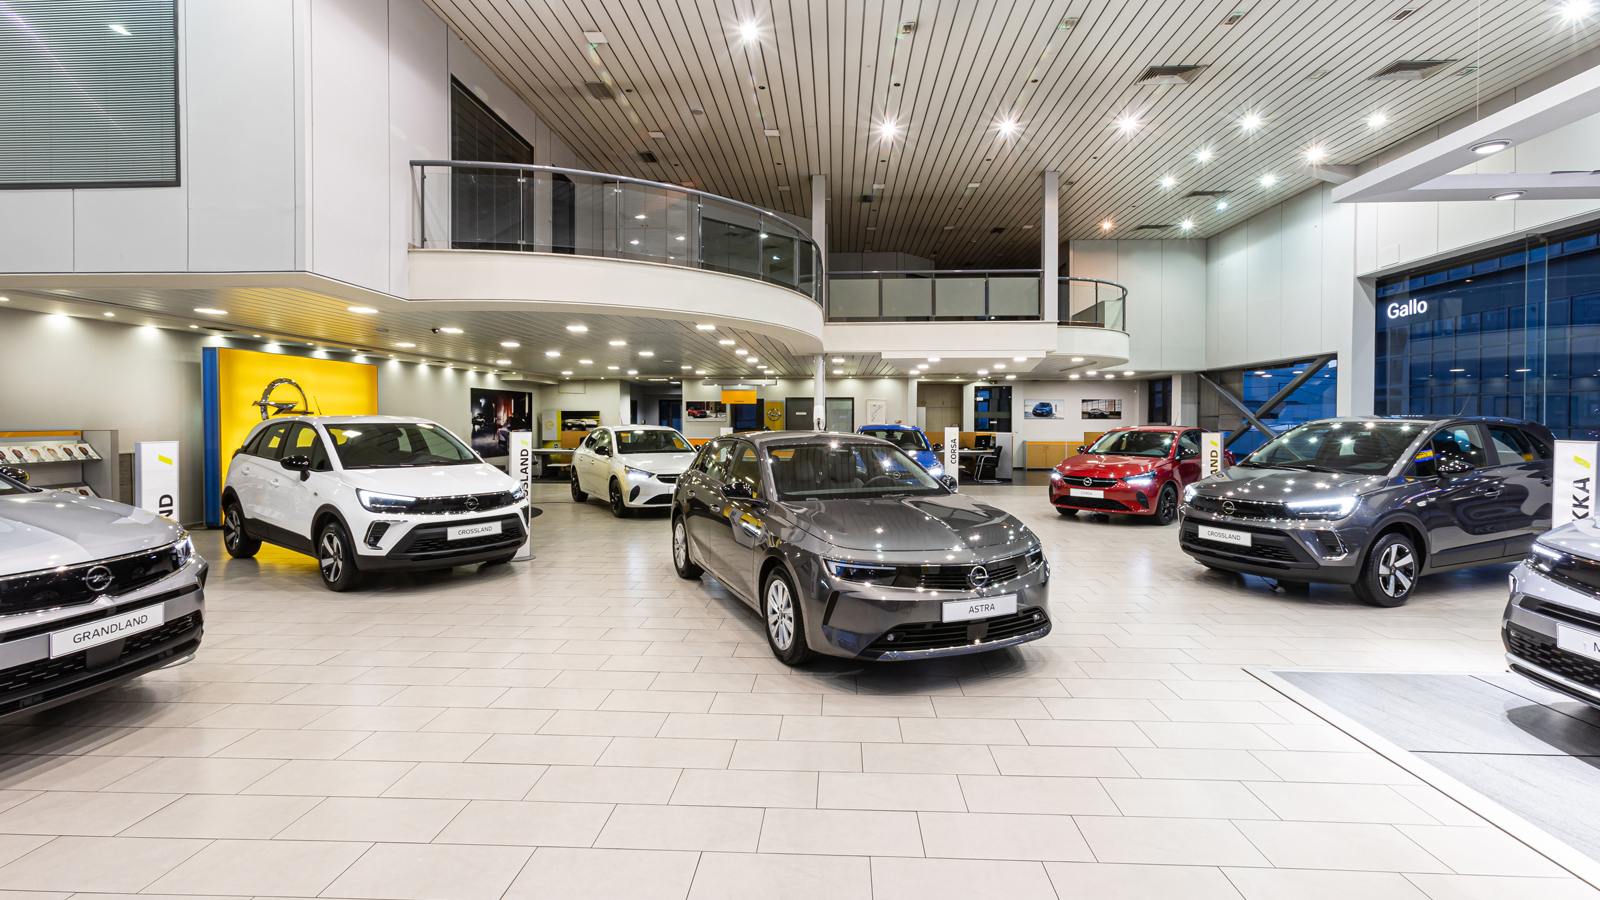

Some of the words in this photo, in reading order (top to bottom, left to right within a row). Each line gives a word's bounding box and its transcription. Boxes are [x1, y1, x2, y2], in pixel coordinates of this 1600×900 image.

[1387, 299, 1428, 319] Gallo
[457, 525, 493, 536] CROSSLAND
[1207, 530, 1241, 541] CROSSLAND
[968, 603, 996, 614] ASTRA
[72, 614, 149, 644] GRANDLAND
